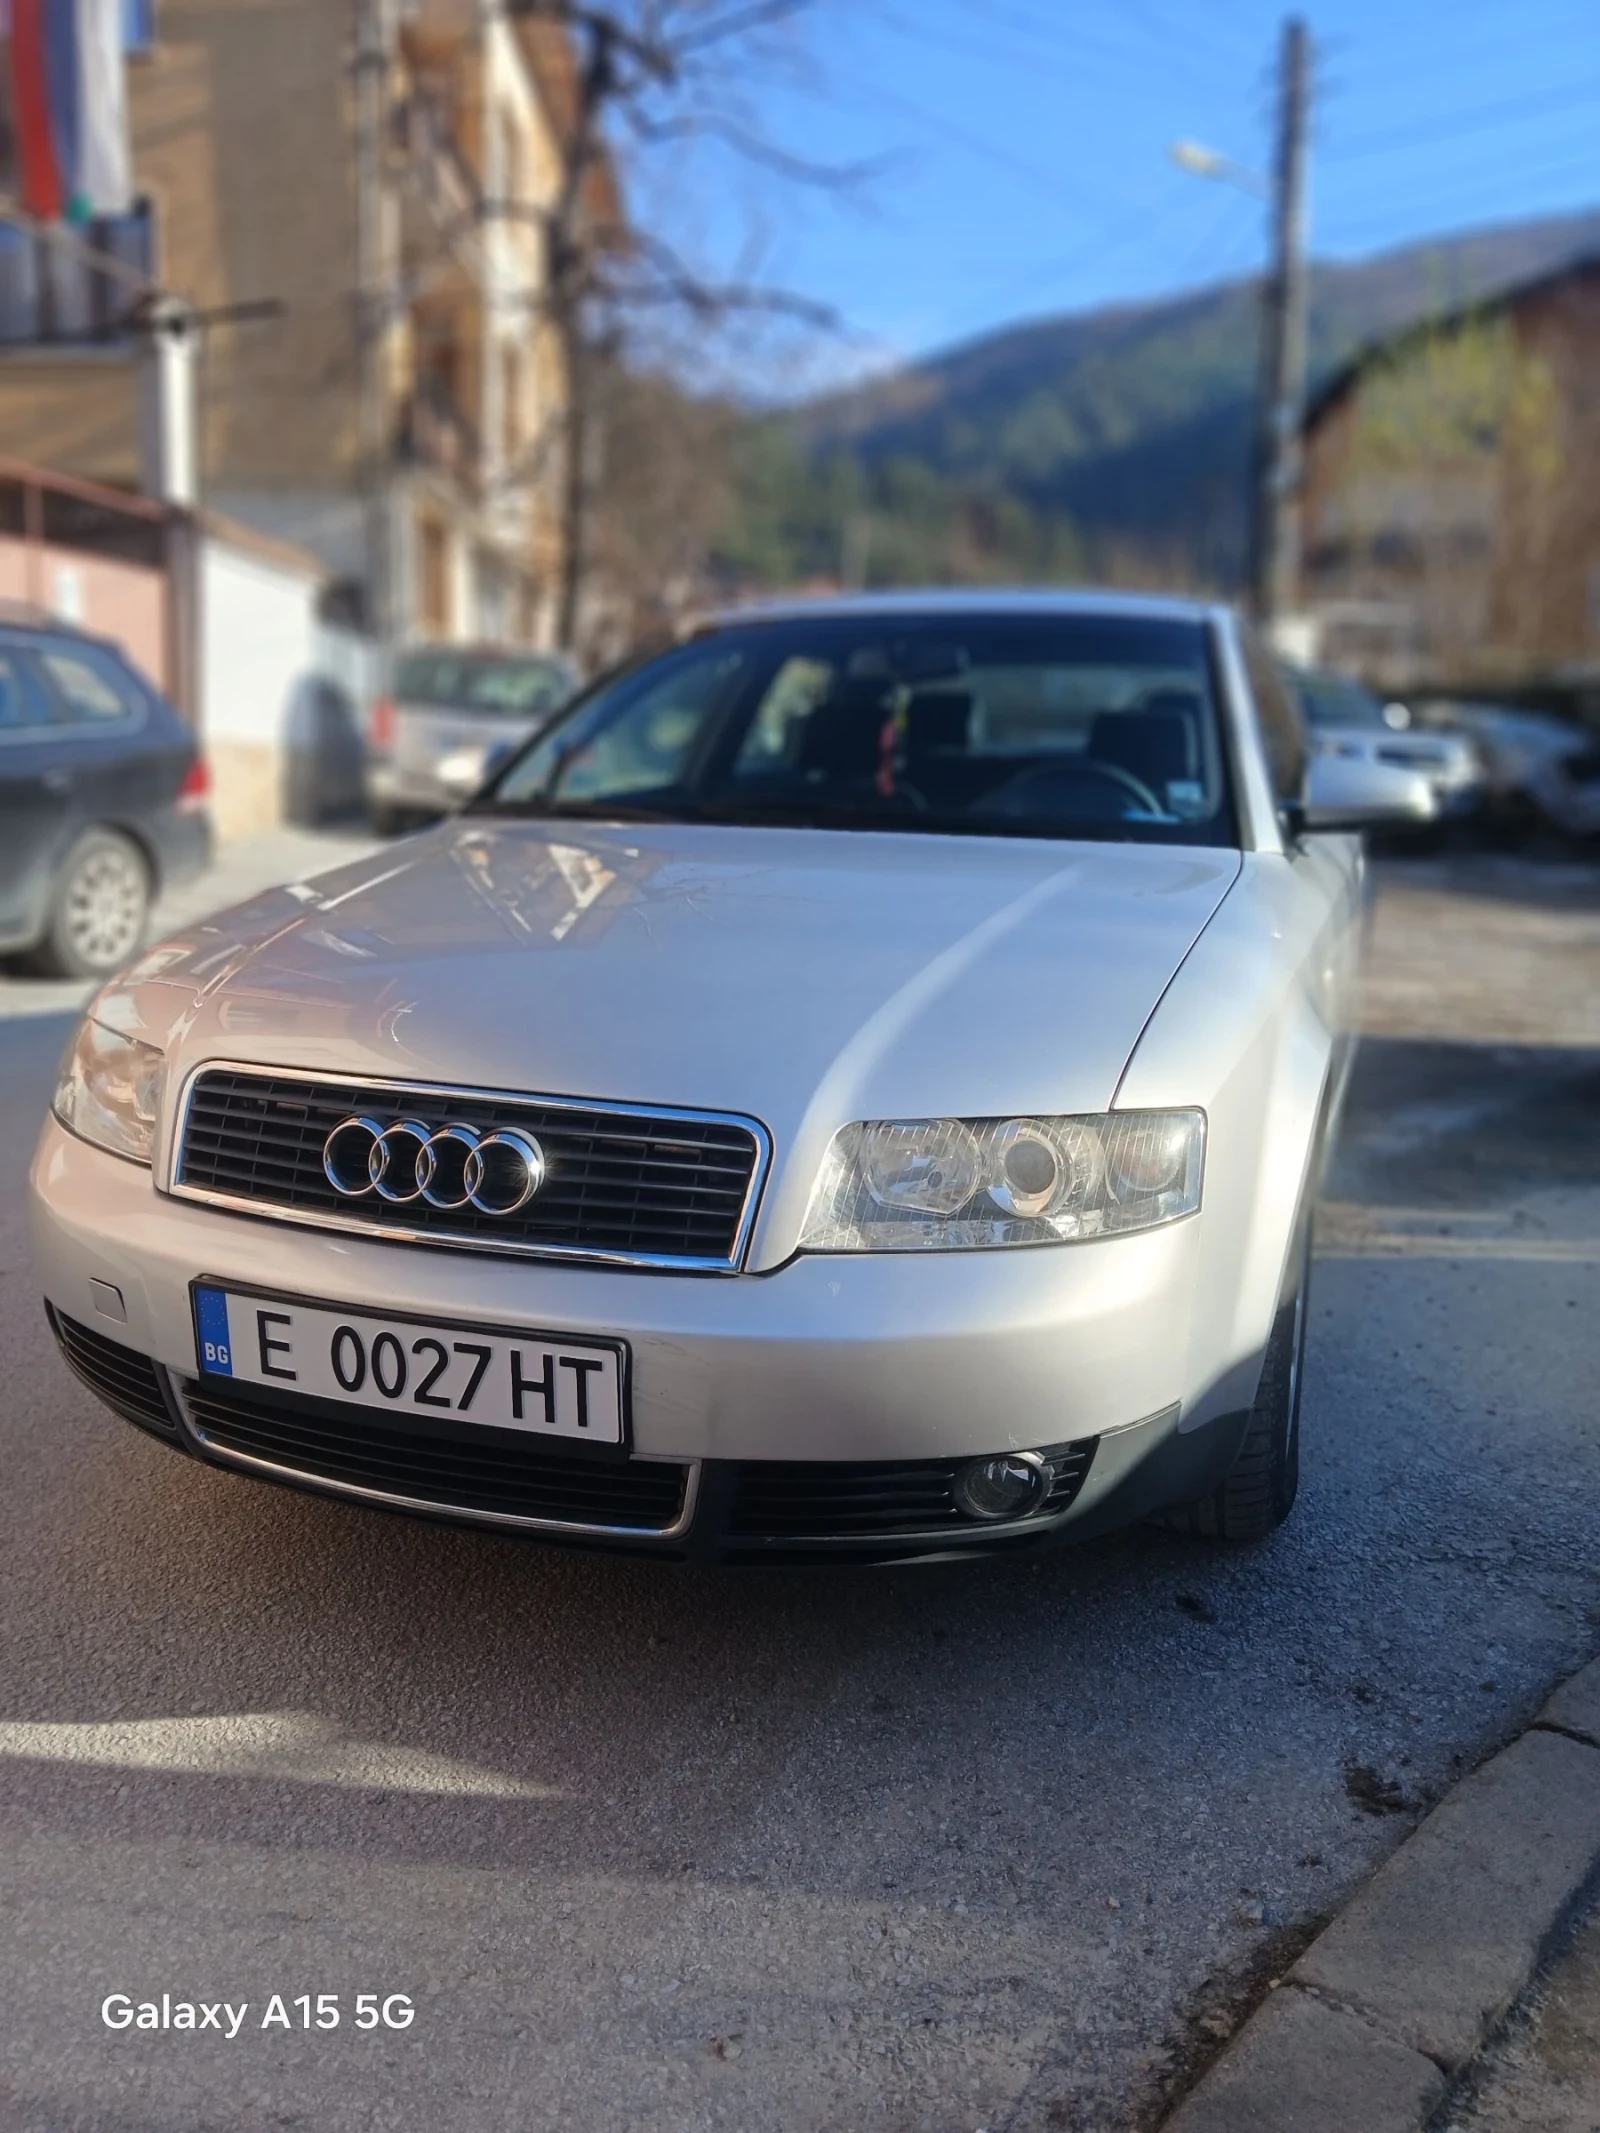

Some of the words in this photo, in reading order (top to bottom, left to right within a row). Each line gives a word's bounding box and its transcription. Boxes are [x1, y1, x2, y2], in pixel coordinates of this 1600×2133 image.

[205, 1343, 229, 1365] BG
[257, 1309, 297, 1381] E
[331, 1325, 492, 1411] 0027
[510, 1349, 603, 1428] HT
